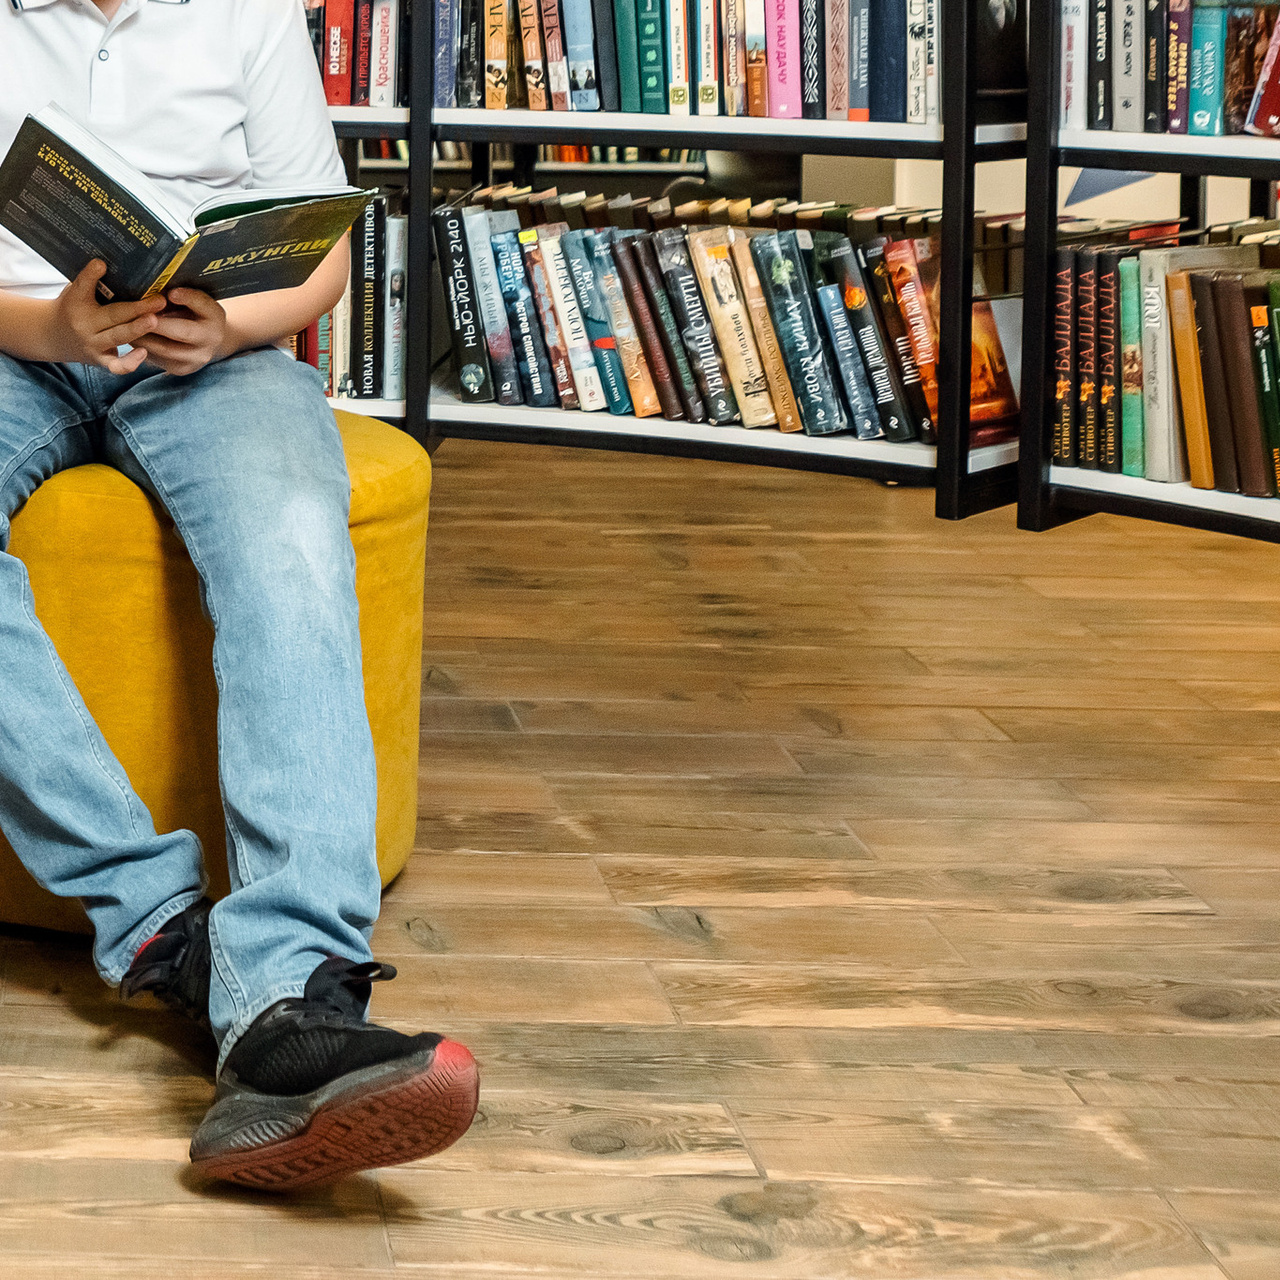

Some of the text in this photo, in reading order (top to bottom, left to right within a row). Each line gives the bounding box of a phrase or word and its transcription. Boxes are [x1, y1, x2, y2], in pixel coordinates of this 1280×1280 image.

[361, 3, 370, 31] КРОВЬ
[1096, 11, 1107, 62] СЛАДКИЙ
[329, 62, 339, 75] Ю
[376, 7, 391, 87] Красношейка
[726, 37, 738, 87] машины
[776, 25, 787, 85] НАУДАЧУ
[1168, 33, 1177, 77] ЛЮБЛЮ
[1168, 80, 1177, 111] ТЕБЯ
[41, 142, 110, 198] ТОЛЬКО ОСТАВШИСЬ
[36, 150, 153, 248] КТО ТЫ НА САМОМ ДЕЛЕ
[202, 237, 331, 273] ДЖУНГЛИ
[447, 219, 477, 347] НЬЮ-ЙОРК 2140
[497, 244, 516, 292] РОБЕРТС
[510, 251, 524, 280] НОРА
[363, 204, 376, 394] НОВАЯ КОЛЛЕКЦИЯ ДЕТЕКТИВОВ
[476, 256, 498, 328] МЫ ЖИВЫЕ
[1055, 266, 1072, 372] БАЛЛАДА
[515, 300, 543, 395] ОСТРОВ СПОКОЙСТВИЯ
[570, 305, 585, 341] НОРА
[678, 273, 727, 398] УБИЙЦЫ СМЕРТИ
[1079, 269, 1096, 374] БАЛЛАДА
[1100, 271, 1116, 377] БАЛЛАДА
[601, 349, 620, 402] АРУНДАТИ РОЙ
[784, 298, 824, 403] ЛИНИЯ КРОВИ
[858, 324, 895, 404] Венец демона
[1062, 403, 1070, 458] СТИВОТЕР
[1086, 406, 1095, 461] СТИВОТЕР
[1106, 408, 1115, 464] СТИВОТЕР
